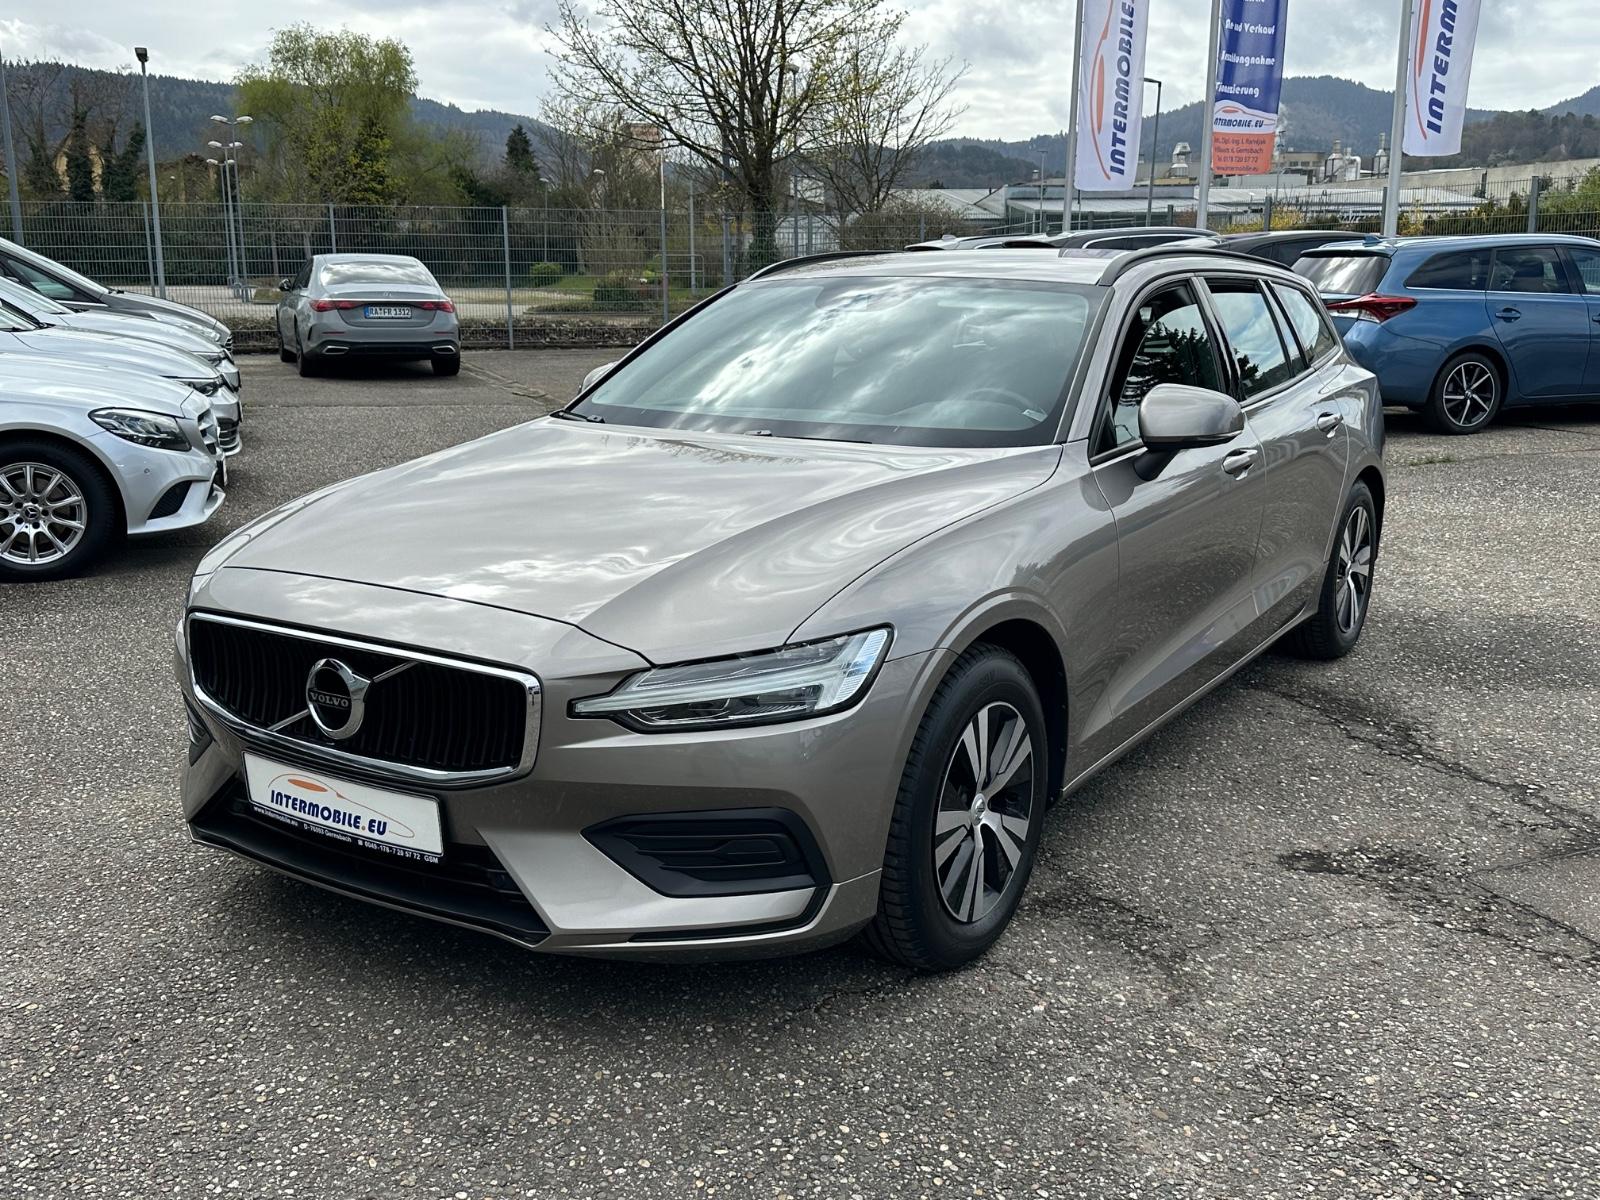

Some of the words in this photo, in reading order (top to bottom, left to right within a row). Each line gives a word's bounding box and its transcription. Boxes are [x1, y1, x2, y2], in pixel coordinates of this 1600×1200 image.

[1244, 23, 1276, 35] Verkauf
[1214, 117, 1265, 128] NTERMOBILE.EU
[369, 307, 378, 316] RA
[383, 307, 392, 316] FR
[309, 692, 349, 707] VOLVO
[270, 789, 388, 836] INTERMOBILE.EU
[413, 852, 420, 860] 72
[424, 855, 438, 864] GSM
